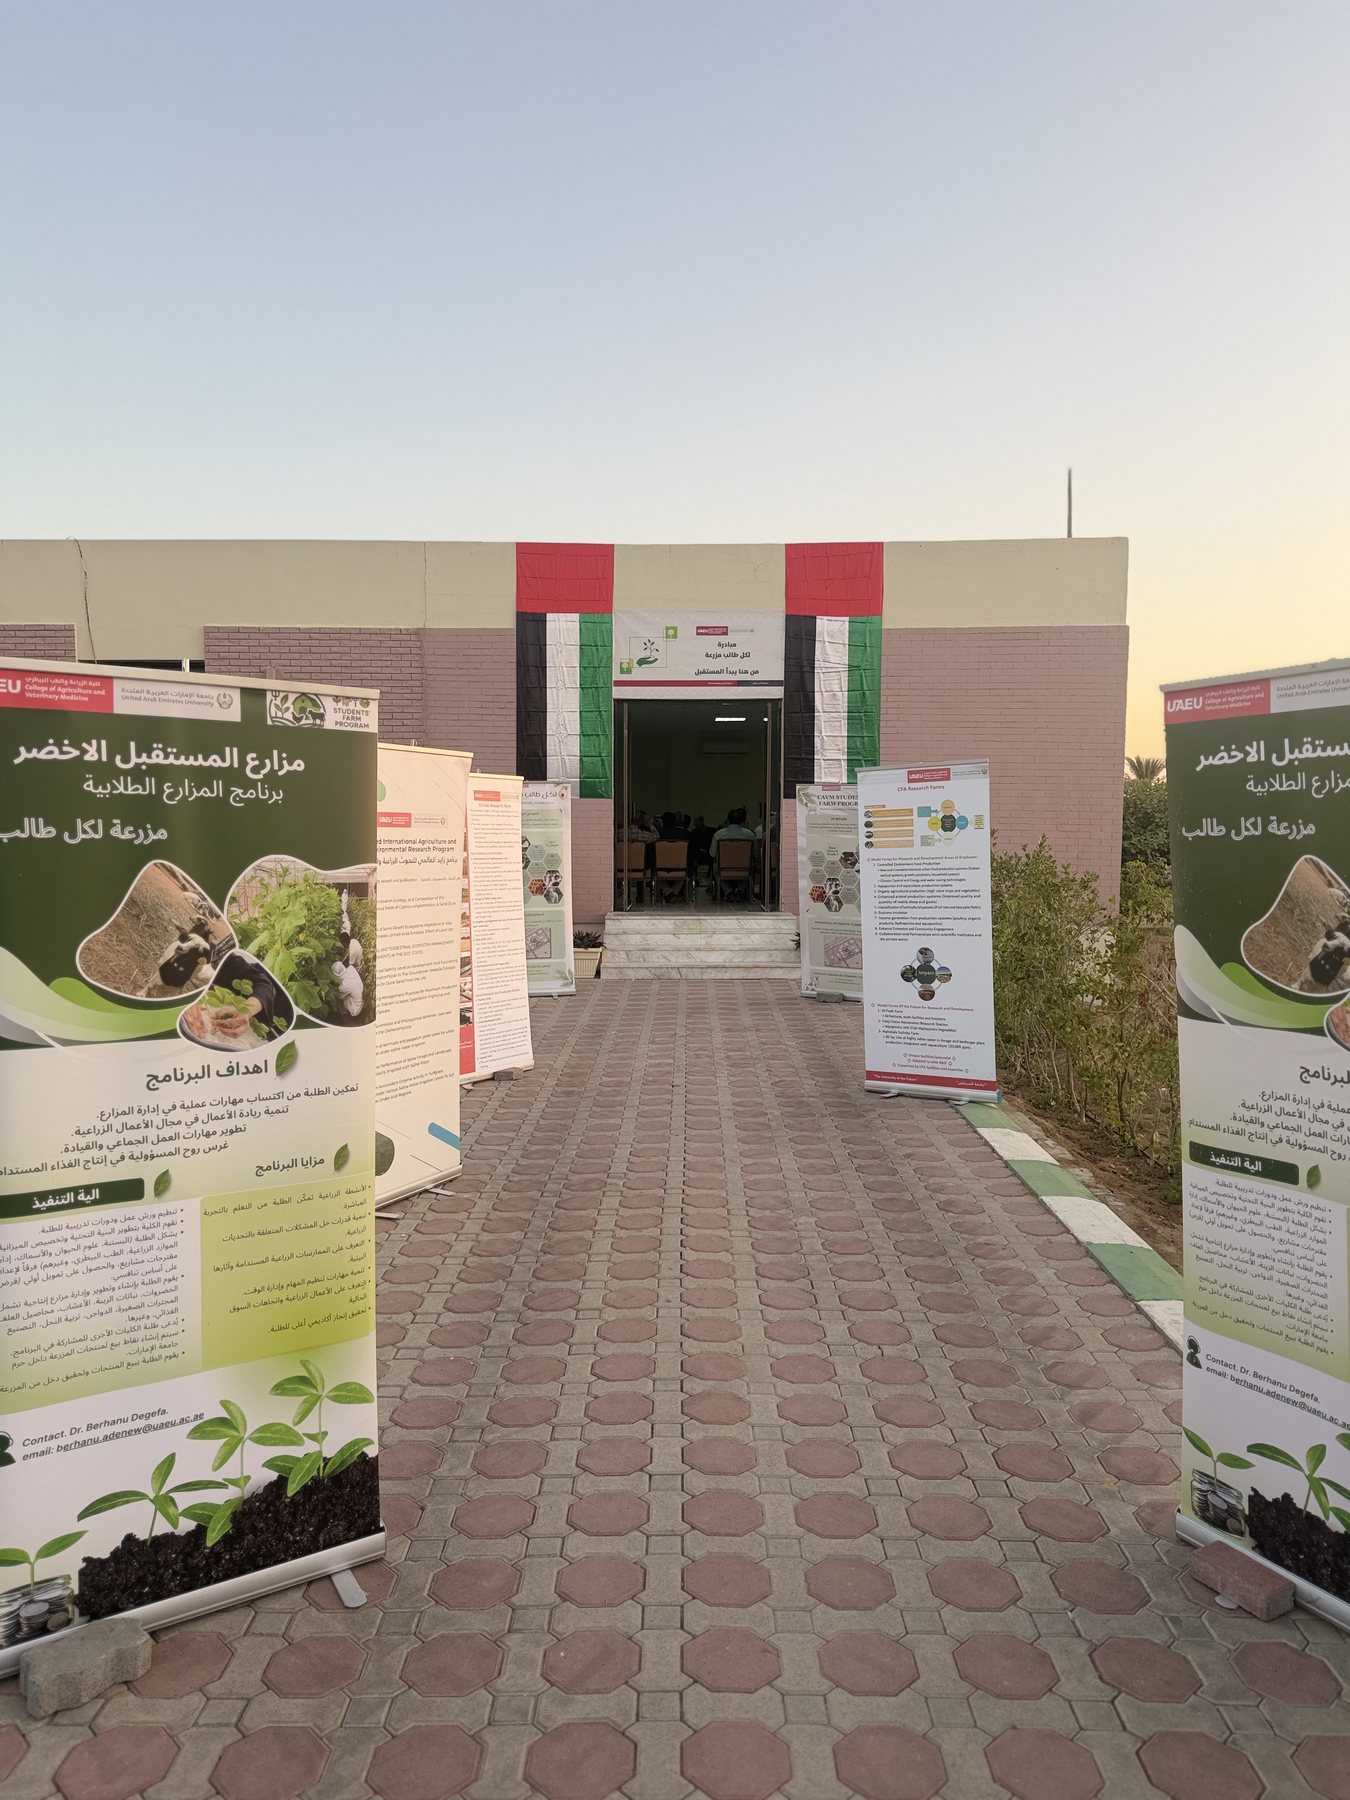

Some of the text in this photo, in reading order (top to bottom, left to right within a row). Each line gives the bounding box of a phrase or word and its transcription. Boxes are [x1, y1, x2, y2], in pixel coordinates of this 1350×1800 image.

[723, 651, 739, 659] طالب
[740, 651, 751, 659] لكل
[726, 666, 738, 676] يبدأ
[25, 684, 48, 692] College
[57, 686, 92, 694] Agriculture
[25, 692, 59, 701] Veterinary
[146, 689, 169, 697] العربية
[185, 699, 214, 708] University
[1167, 696, 1203, 713] UAEU
[1228, 694, 1254, 702] Agriculture
[334, 721, 370, 729] PROGRAM
[13, 738, 305, 779] مزارع المستقبل الاخضر
[1196, 740, 1265, 772] الاخضر
[83, 774, 283, 807] برنامج المزارع الطلابية
[1246, 772, 1306, 796] الطلابية
[0, 817, 168, 845] مزرعة لكل طالب
[1182, 815, 1316, 841] مزرعة لكل طالب
[382, 838, 418, 846] International
[418, 838, 447, 847] Agriculture
[432, 846, 455, 854] Program
[146, 1059, 268, 1092] اهداف البرنامج
[96, 1083, 359, 1122] تمكين الطلبة من اكتساب مهارات عملية في إدارة المزارع.
[1258, 1091, 1290, 1102] المزارع.
[1292, 1094, 1311, 1109] إدارة
[1312, 1099, 1325, 1110] في
[71, 1105, 289, 1138] تنمية ريادة الأعمال في مجال الأعمال الزراعية.
[1238, 1099, 1345, 1130] في مجال الأعمال الزراعية.
[1230, 1112, 1328, 1140] العمل الجماعي والقيادة.
[60, 1124, 247, 1154] تطوير مهارات العمل الجماعي والقيادة.
[1187, 1118, 1346, 1161] روح المسؤولية في إنتاج الغذاء المستدام.
[183, 1148, 200, 1159] روح
[203, 1140, 229, 1154] غرس
[110, 1152, 126, 1168] في
[128, 1147, 180, 1163] المسؤولية
[1210, 1151, 1262, 1172] الية التنفيذ
[51, 1158, 80, 1171] الغذاء
[83, 1155, 107, 1171] إنتاج
[255, 1156, 325, 1177] مزايا البرنامج
[32, 1188, 99, 1210] الية التنفيذ
[91, 1218, 118, 1226] ودورات
[120, 1215, 136, 1224] عمل
[139, 1212, 156, 1221] ورش
[158, 1209, 178, 1220] تنظيم
[65, 1220, 90, 1230] تدريبية
[1206, 1366, 1228, 1379] email:
[1206, 1353, 1320, 1404] Contact. Dr. Berhanu Degefa.
[22, 1408, 168, 1447] Contact. Dr. Berhanu Degefa.
[22, 1413, 204, 1461] email: berhanu.adenew@uaeu.ac.ae
